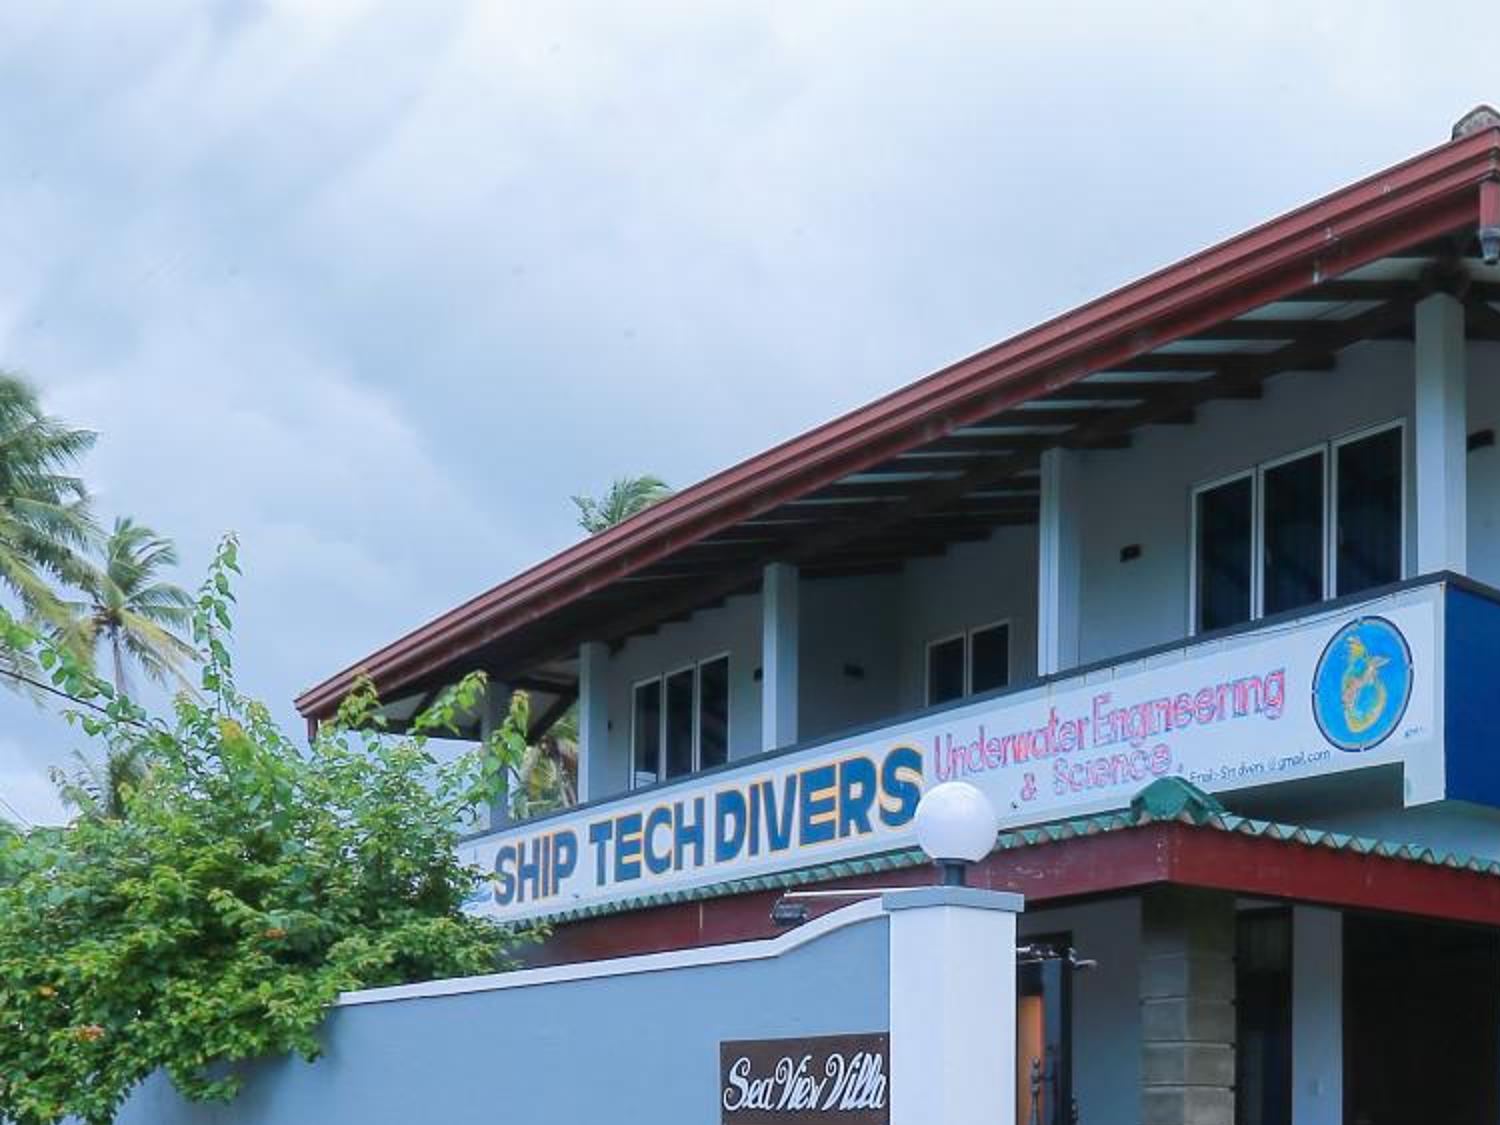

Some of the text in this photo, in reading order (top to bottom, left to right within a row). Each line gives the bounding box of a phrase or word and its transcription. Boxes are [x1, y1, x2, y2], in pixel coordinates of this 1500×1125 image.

[933, 667, 1286, 782] Underwater Engineering
[1021, 743, 1172, 800] & Science
[494, 746, 924, 906] SHIP TECH DIVERS
[724, 1057, 774, 1110] Sea
[822, 1052, 887, 1110] Villa
